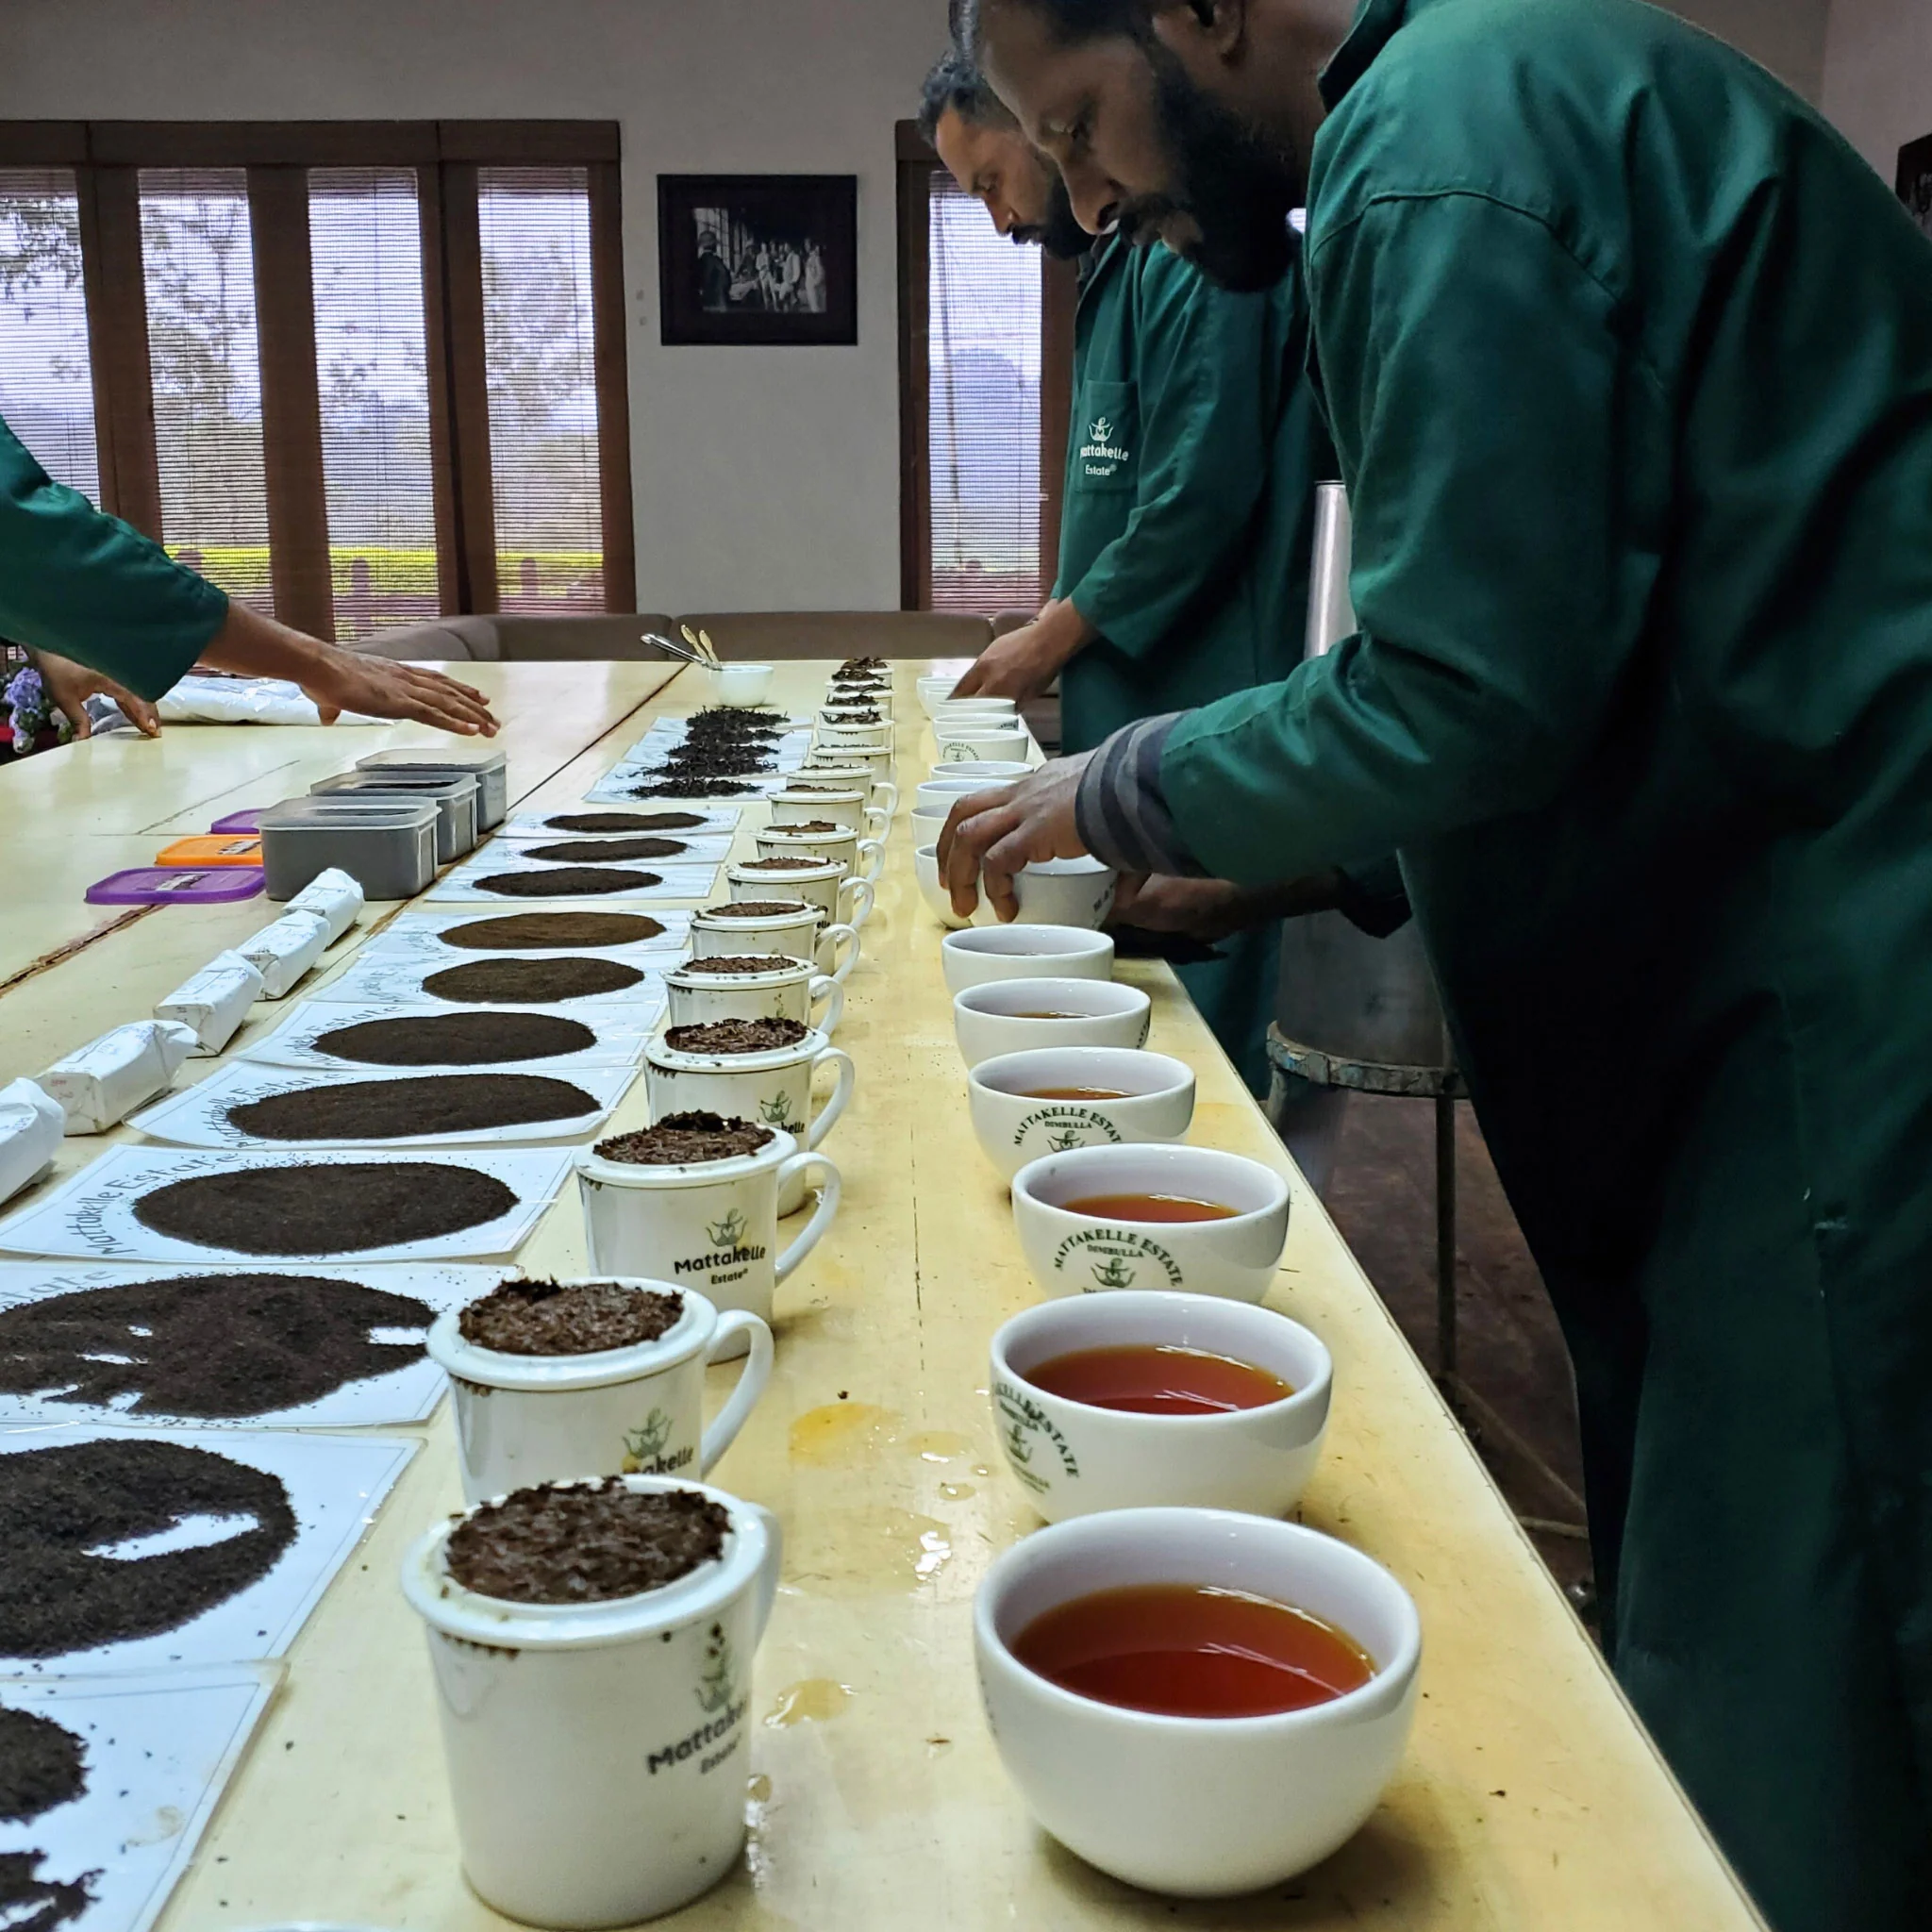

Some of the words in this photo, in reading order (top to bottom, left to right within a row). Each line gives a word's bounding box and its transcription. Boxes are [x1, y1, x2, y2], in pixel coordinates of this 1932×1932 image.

[1014, 1107, 1088, 1147] MATTAKELLE
[1090, 1111, 1123, 1143] ESTAT
[674, 1245, 766, 1274] Mattakelle
[1055, 1228, 1139, 1272] MATTAKELLE
[1140, 1238, 1184, 1287] ESTATE
